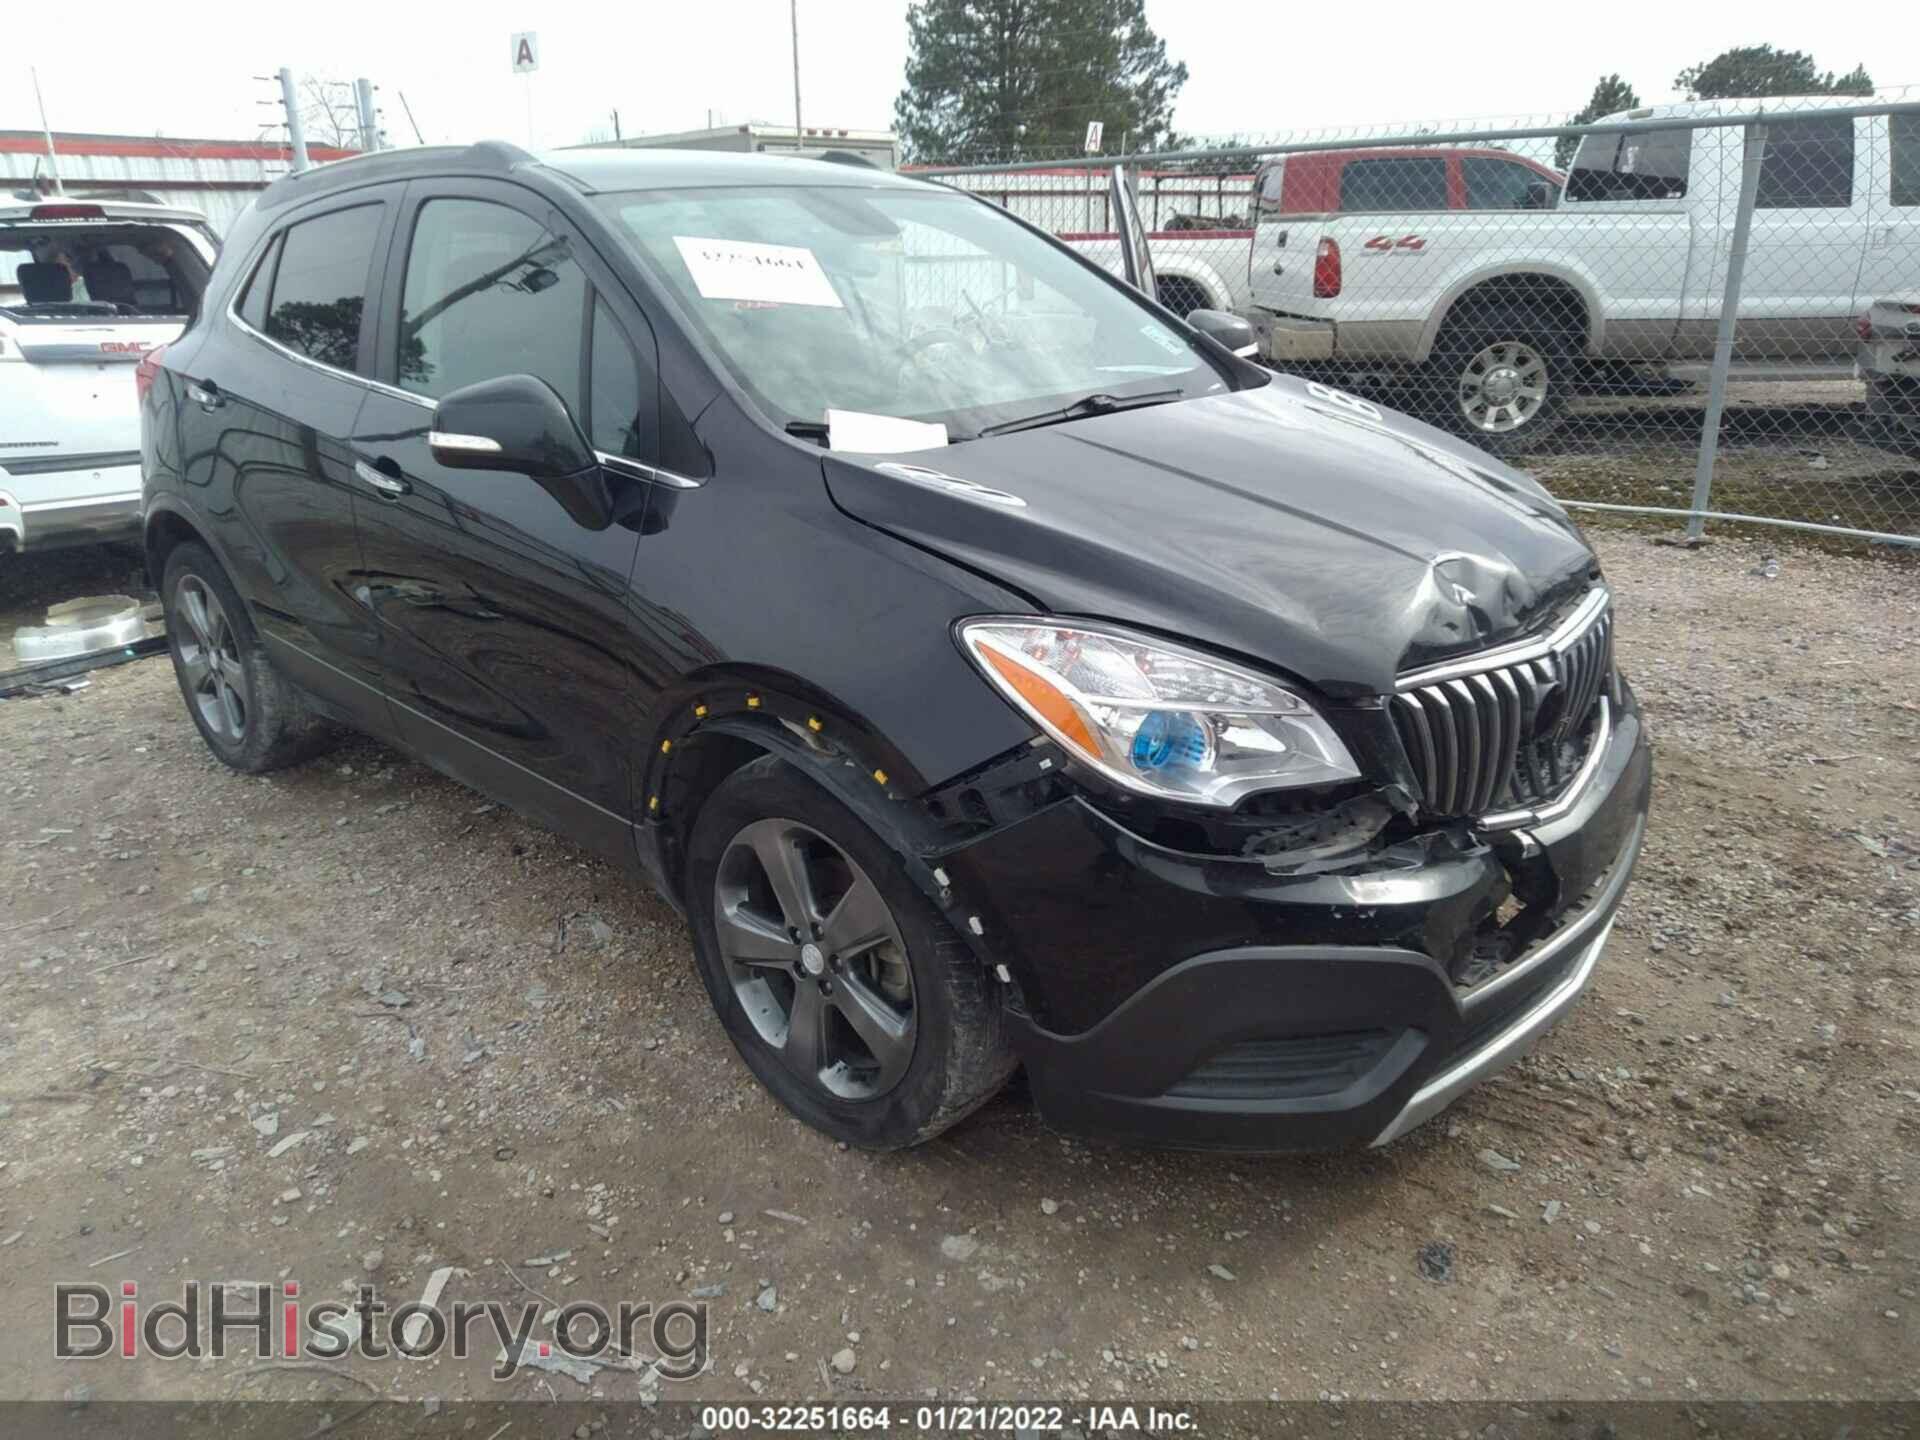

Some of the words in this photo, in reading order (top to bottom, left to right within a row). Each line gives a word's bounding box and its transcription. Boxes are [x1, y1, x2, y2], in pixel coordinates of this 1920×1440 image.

[516, 38, 534, 65] A
[1086, 124, 1100, 150] A
[100, 341, 151, 353] GMC
